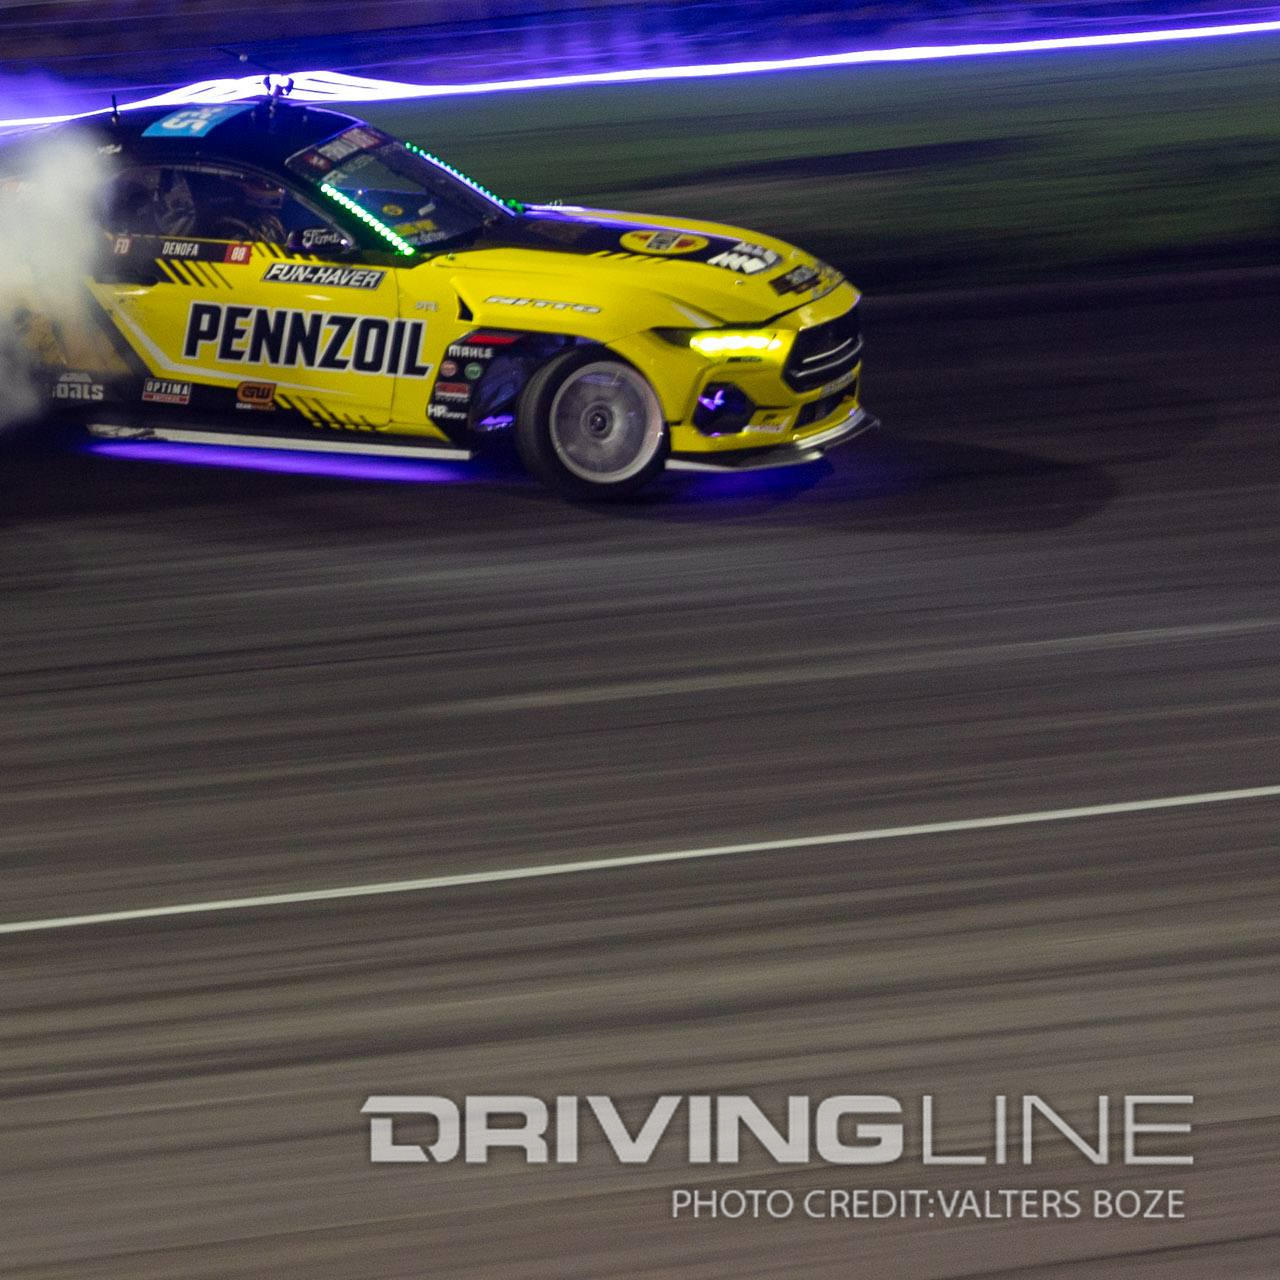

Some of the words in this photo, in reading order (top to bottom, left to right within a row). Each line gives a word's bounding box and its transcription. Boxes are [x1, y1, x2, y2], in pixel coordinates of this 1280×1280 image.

[162, 241, 199, 256] DENOFA
[266, 264, 380, 288] FUN-HAVER
[183, 301, 432, 378] PENNZOIL
[448, 345, 493, 359] MAHLE
[146, 381, 188, 395] OPTIMA
